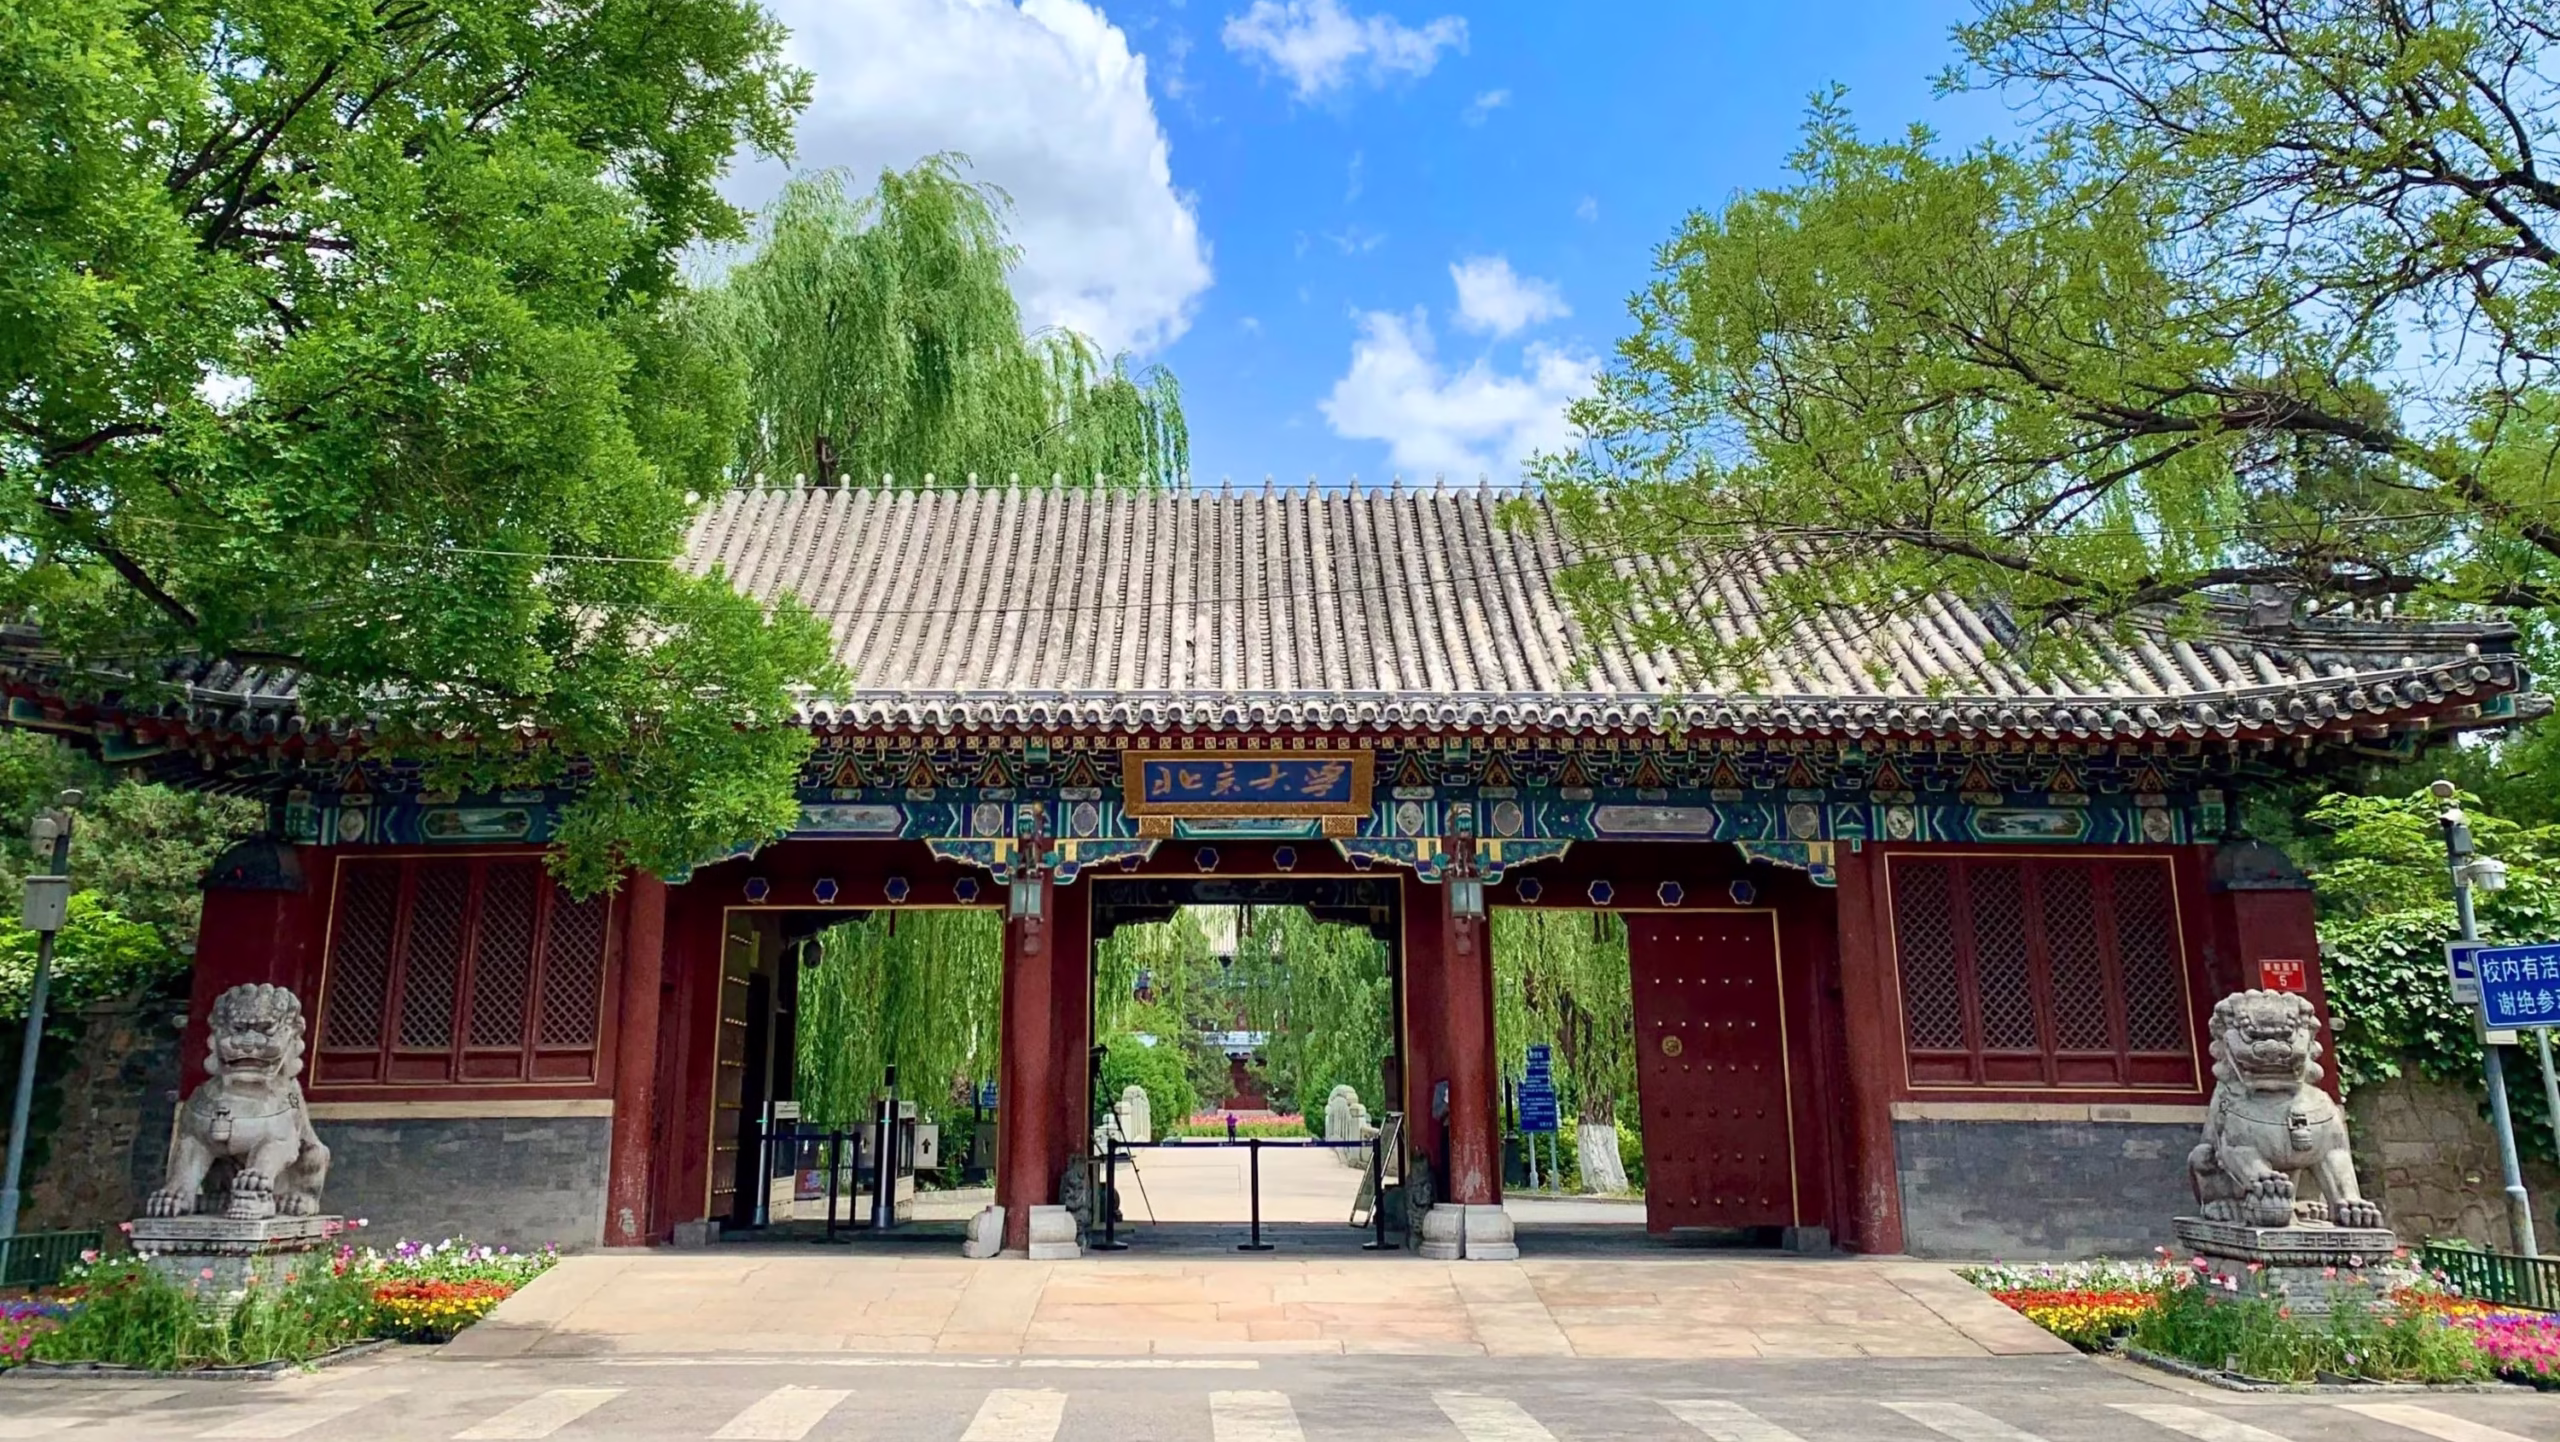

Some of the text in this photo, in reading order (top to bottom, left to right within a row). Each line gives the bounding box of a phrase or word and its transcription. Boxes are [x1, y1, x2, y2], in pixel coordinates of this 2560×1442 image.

[2482, 954, 2560, 983] 校内有活
[2279, 975, 2288, 987] 5
